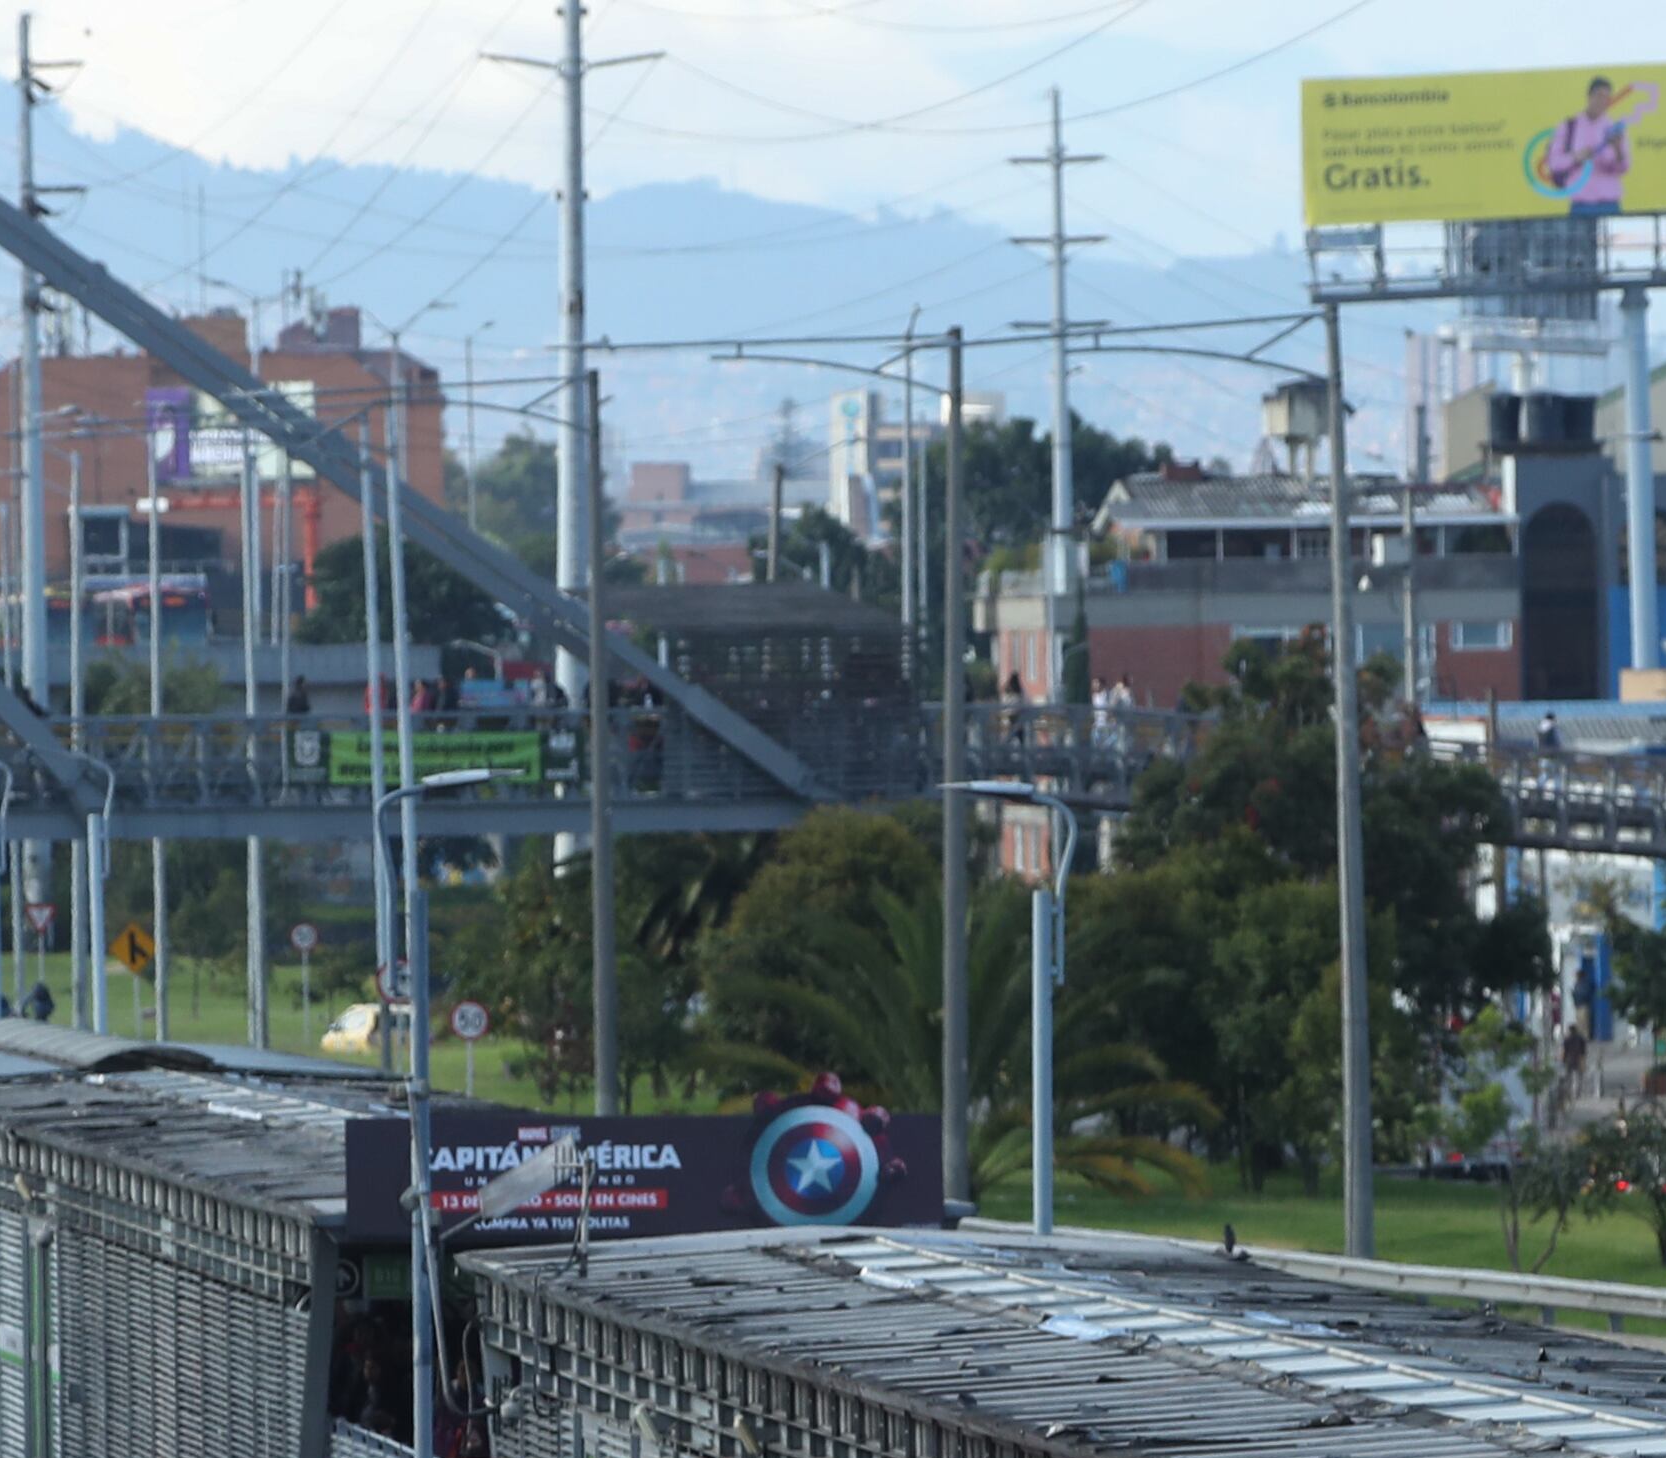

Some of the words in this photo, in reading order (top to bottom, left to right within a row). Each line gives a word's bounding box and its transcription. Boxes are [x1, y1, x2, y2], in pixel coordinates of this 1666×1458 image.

[1324, 160, 1430, 190] Gratis.
[429, 1142, 540, 1171] APITÁN
[595, 1193, 615, 1205] EN
[618, 1193, 658, 1205] CINES
